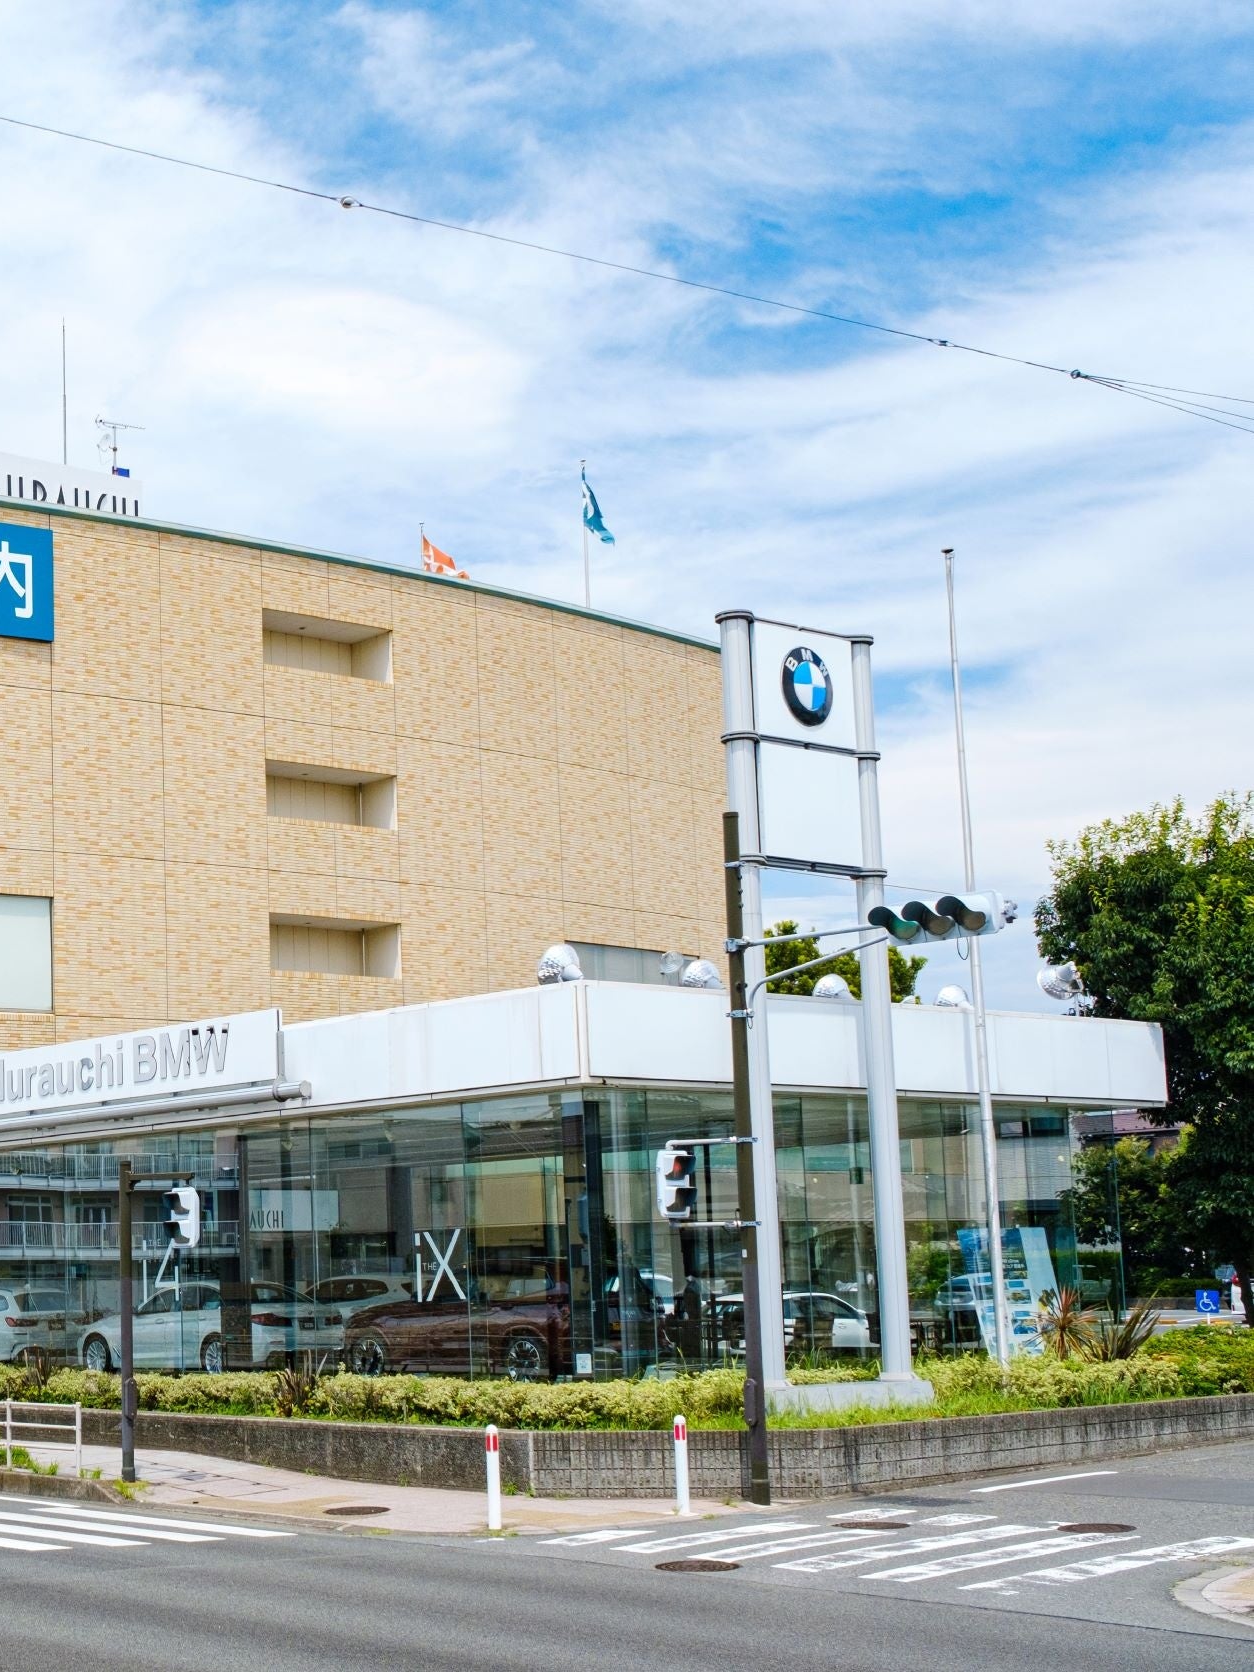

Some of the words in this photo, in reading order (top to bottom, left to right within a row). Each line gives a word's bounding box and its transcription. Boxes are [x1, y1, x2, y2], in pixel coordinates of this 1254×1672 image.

[132, 1022, 230, 1085] BMW
[414, 1228, 467, 1303] iX
[422, 1261, 438, 1271] THE
